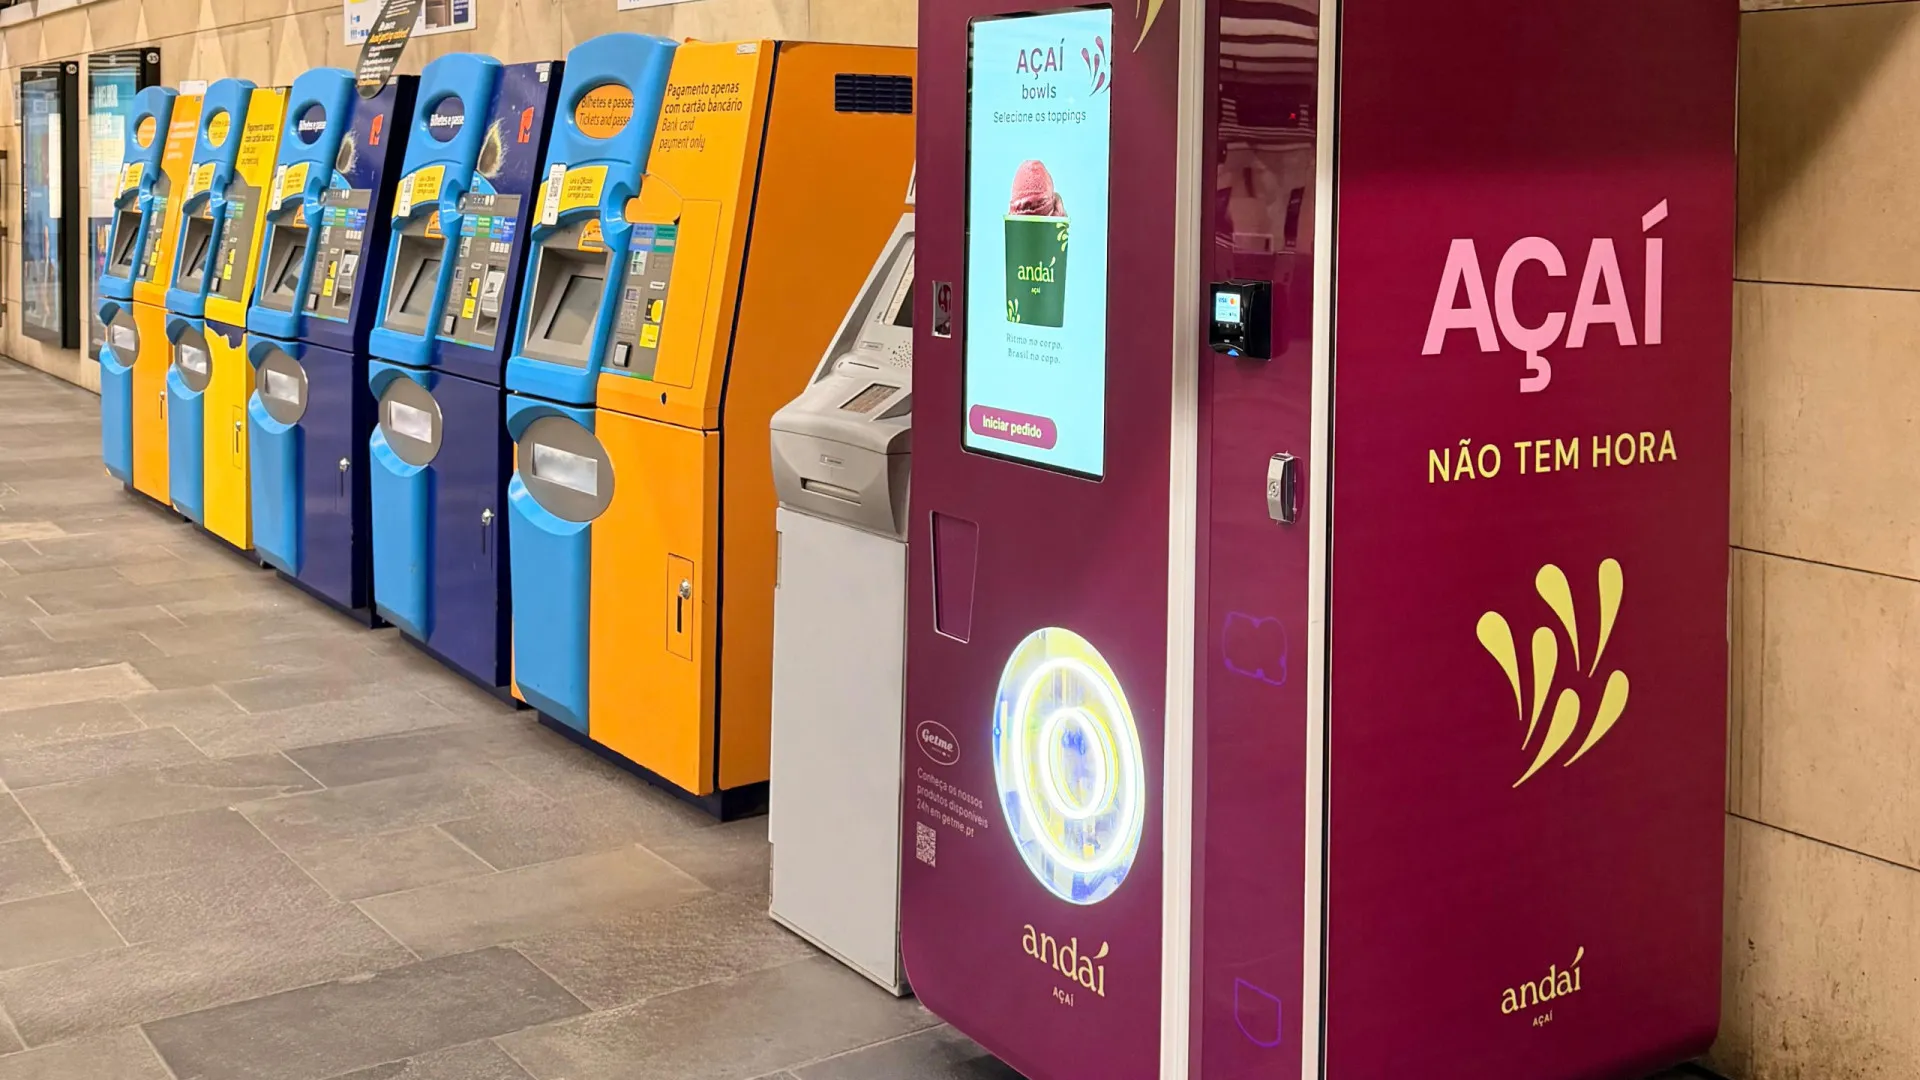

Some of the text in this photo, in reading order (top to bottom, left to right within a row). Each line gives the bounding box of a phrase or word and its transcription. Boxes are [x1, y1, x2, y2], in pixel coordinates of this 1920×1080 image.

[1016, 37, 1065, 80] AÇAÍ
[581, 95, 606, 108] Bilhetes
[607, 99, 612, 108] e
[667, 82, 740, 100] Pagamento apenas
[1022, 83, 1057, 100] bowls
[664, 97, 743, 114] com cartão bancário
[579, 112, 600, 125] Tickets
[600, 112, 613, 126] and
[661, 116, 696, 131] Bank card
[993, 109, 1086, 124] Selecione os toppings
[658, 134, 706, 152] payment only
[1017, 256, 1056, 283] andaí
[1421, 198, 1669, 393] AÇAÍ
[1006, 333, 1063, 350] Ritmo no corpo.
[1008, 348, 1061, 365] Brasil no copo.
[982, 414, 1042, 438] Iniciar pedido
[1428, 429, 1677, 483] NÃO TEM HORA
[921, 729, 954, 752] Getme
[917, 767, 983, 809] Conheça os nossos
[917, 785, 948, 807] produtos
[917, 798, 975, 838] 24h em getme.pt
[1022, 924, 1109, 997] andaí
[1501, 946, 1585, 1014] andaí
[1052, 986, 1074, 1007] AÇAÍ
[1532, 1009, 1553, 1027] AÇAÍ
